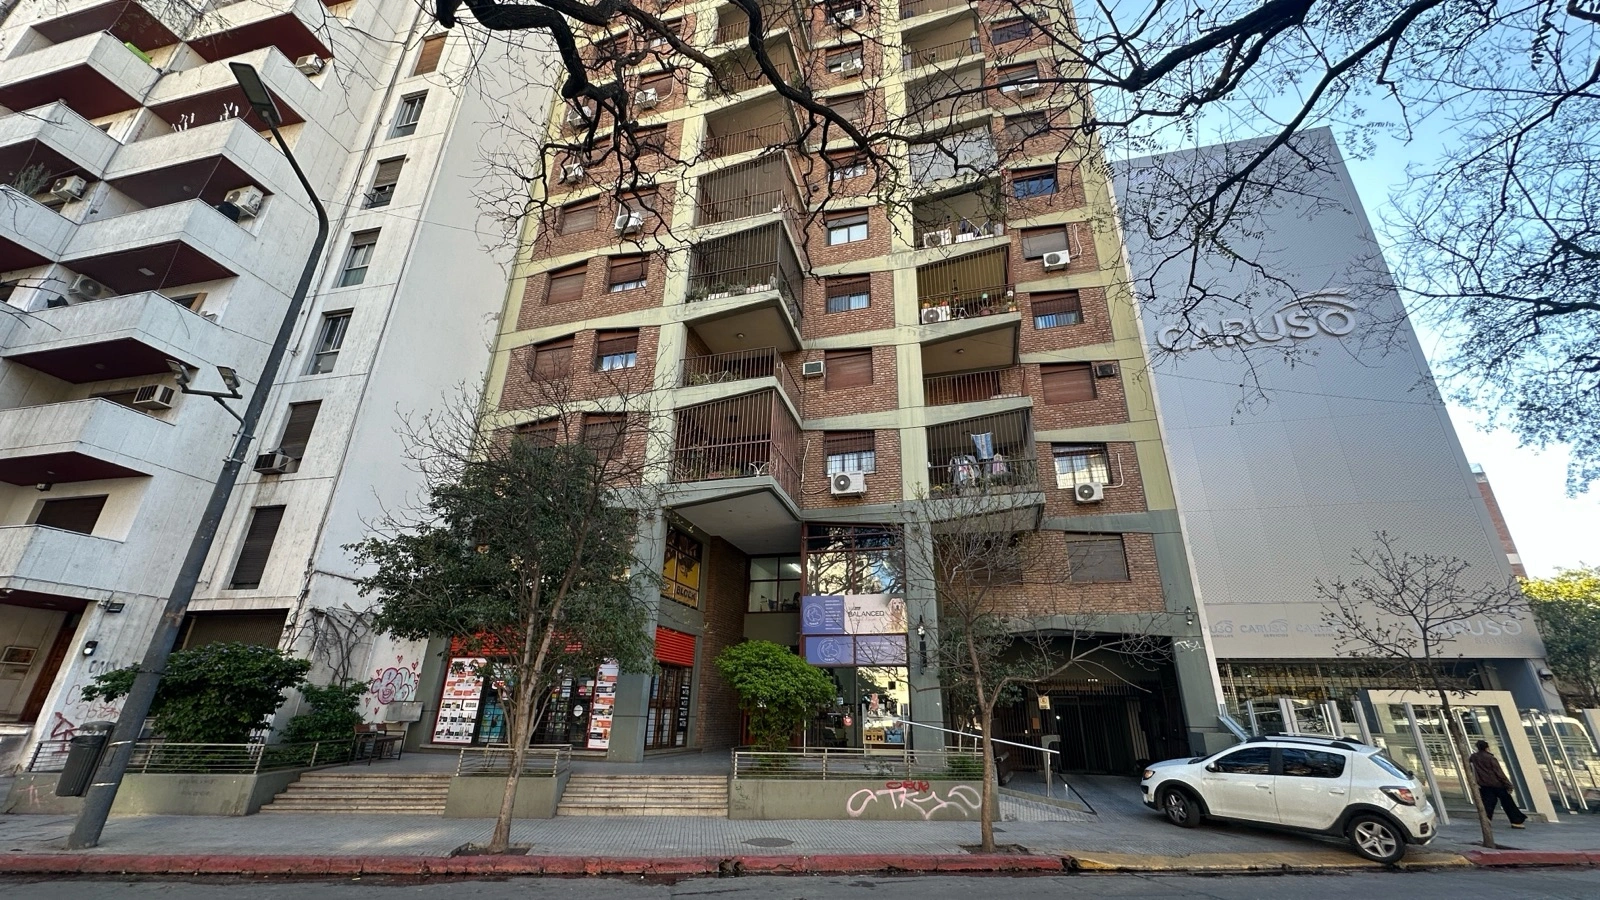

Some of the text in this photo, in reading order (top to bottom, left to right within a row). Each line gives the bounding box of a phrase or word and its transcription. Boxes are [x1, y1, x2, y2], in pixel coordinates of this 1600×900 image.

[1157, 309, 1356, 352] CARUSO
[676, 585, 697, 601] BLOCK
[1239, 624, 1289, 634] CARUSO
